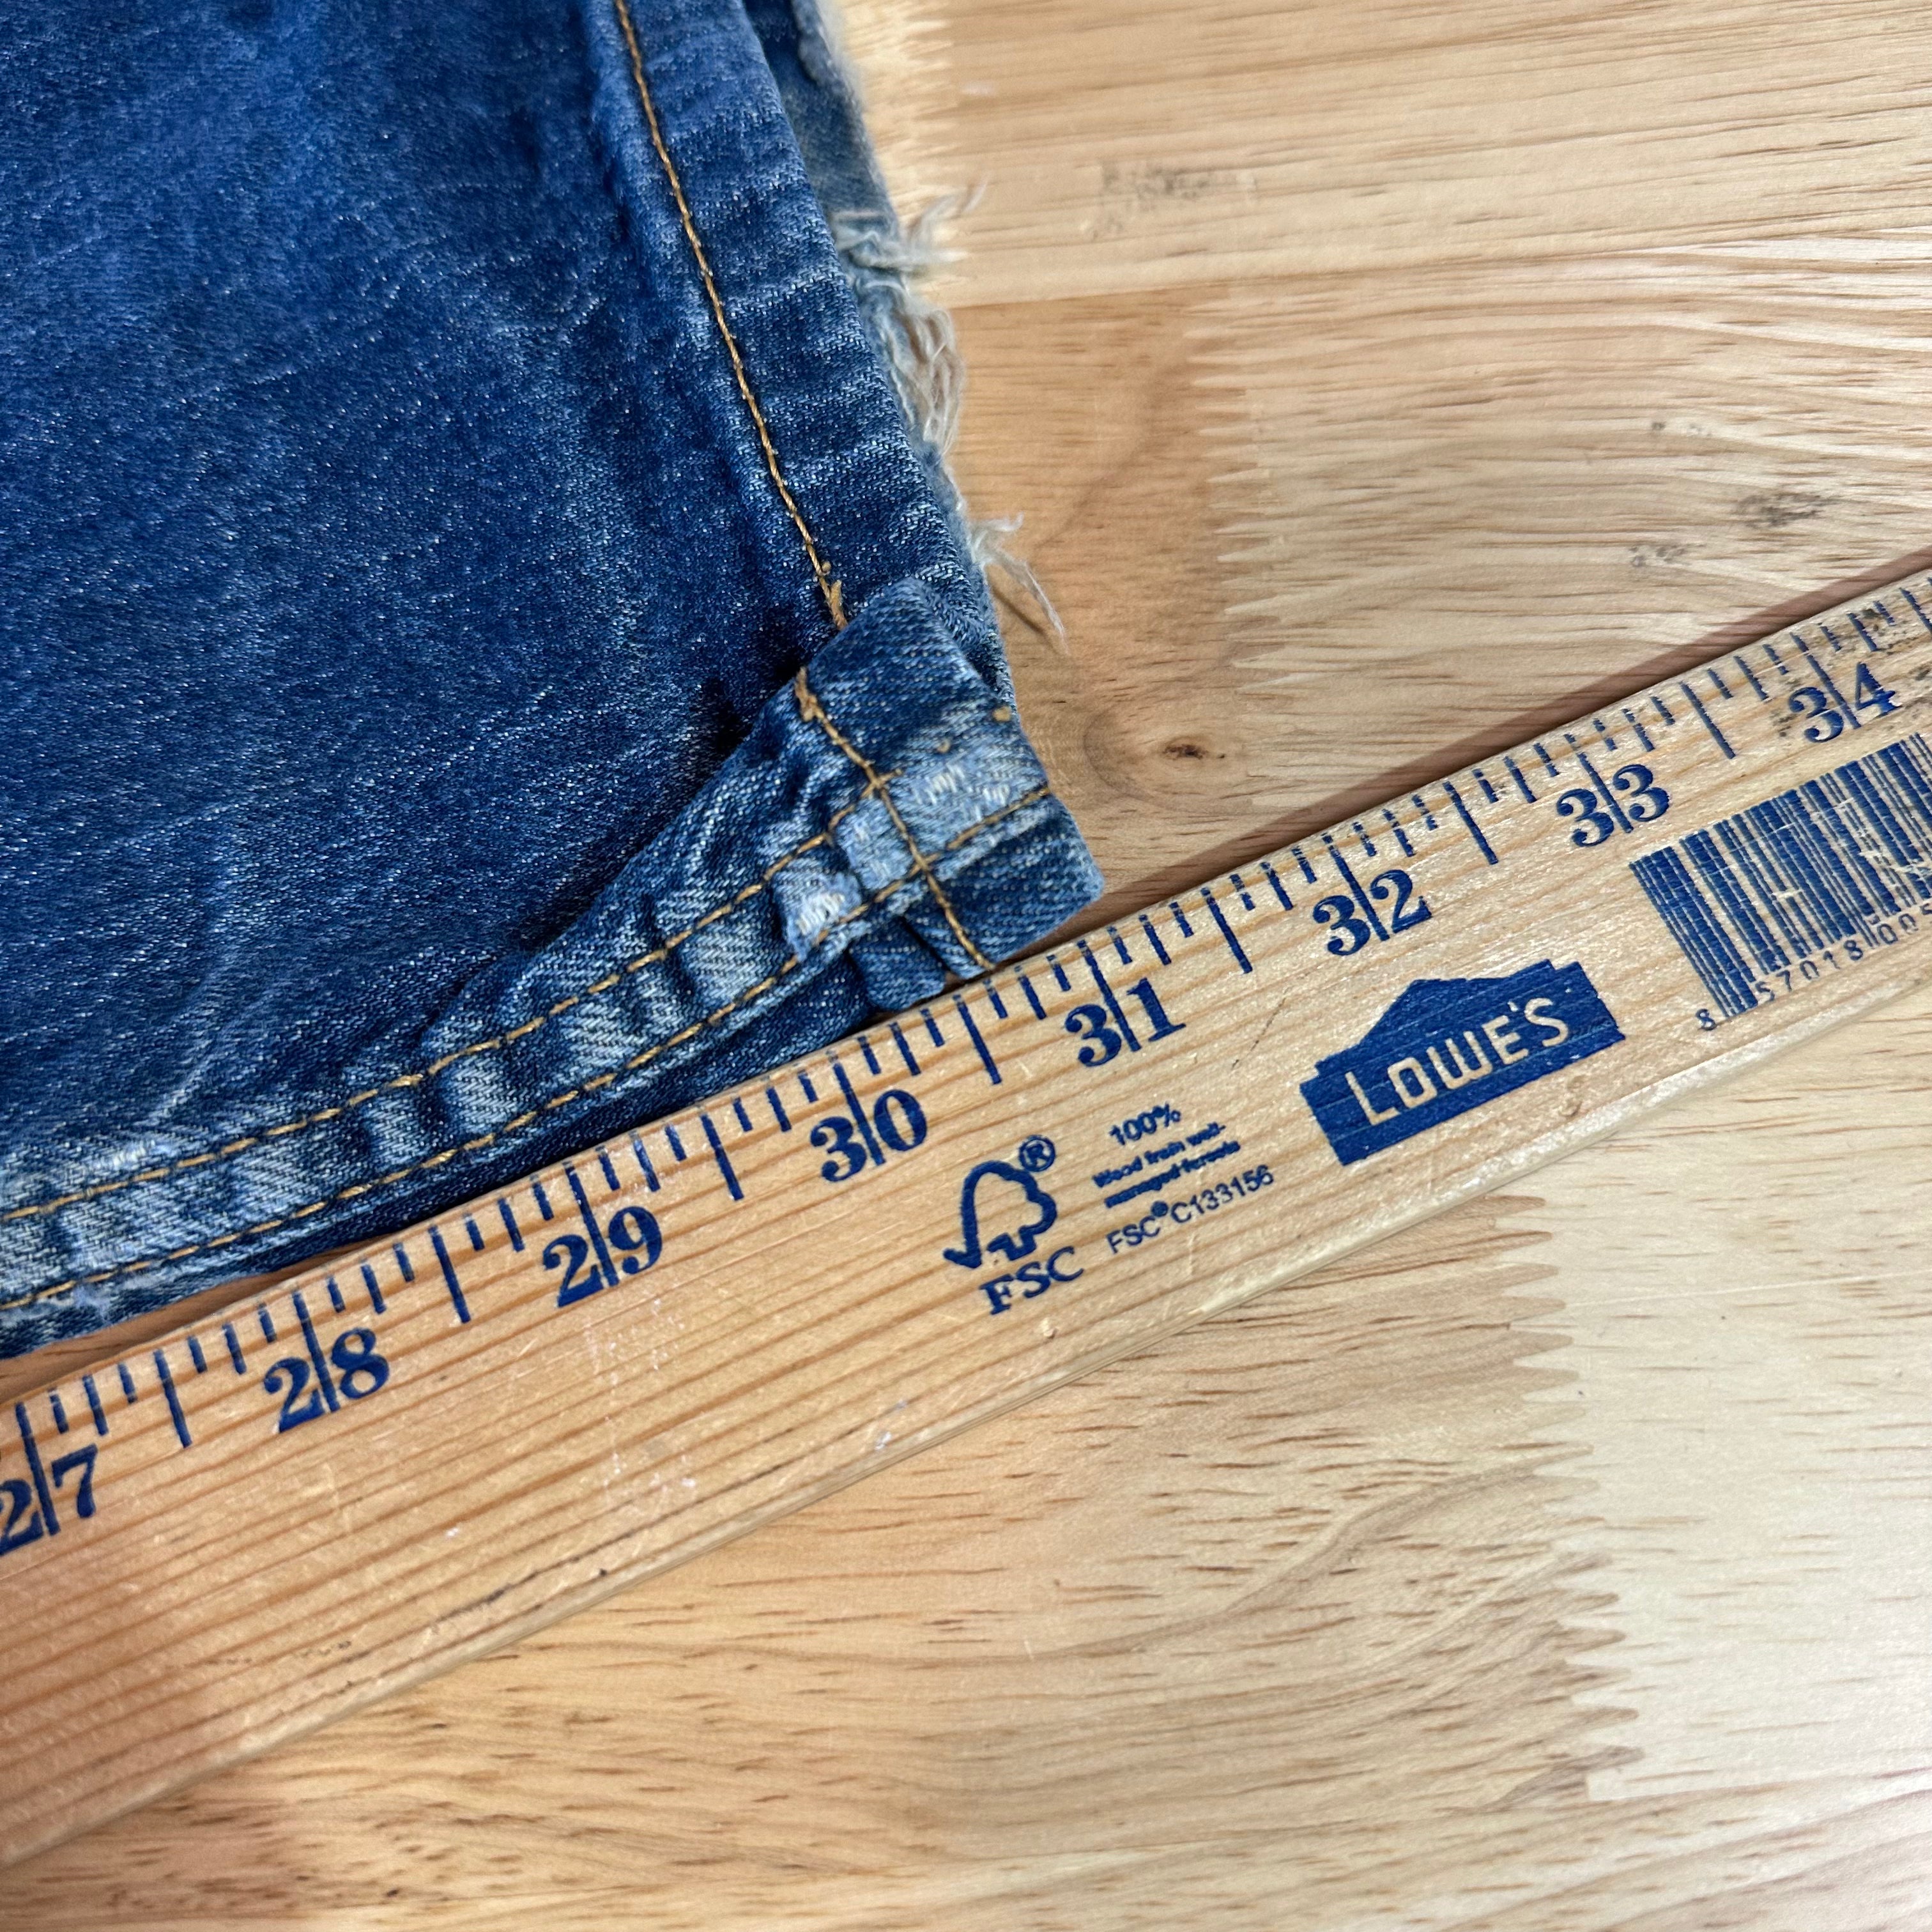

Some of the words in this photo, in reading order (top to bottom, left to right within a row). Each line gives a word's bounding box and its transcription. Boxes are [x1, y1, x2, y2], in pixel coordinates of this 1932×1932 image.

[0, 1444, 97, 1557] 27
[263, 1328, 389, 1432] 28
[542, 1206, 662, 1307] 29
[810, 1089, 928, 1183] 30
[1064, 977, 1186, 1067] 31
[1313, 869, 1432, 955] 32
[1556, 764, 1670, 847] 33
[1790, 663, 1902, 742] 34
[1345, 998, 1569, 1126] LOWE'S
[1109, 1102, 1181, 1145] 100%
[979, 1246, 1084, 1315] FSC
